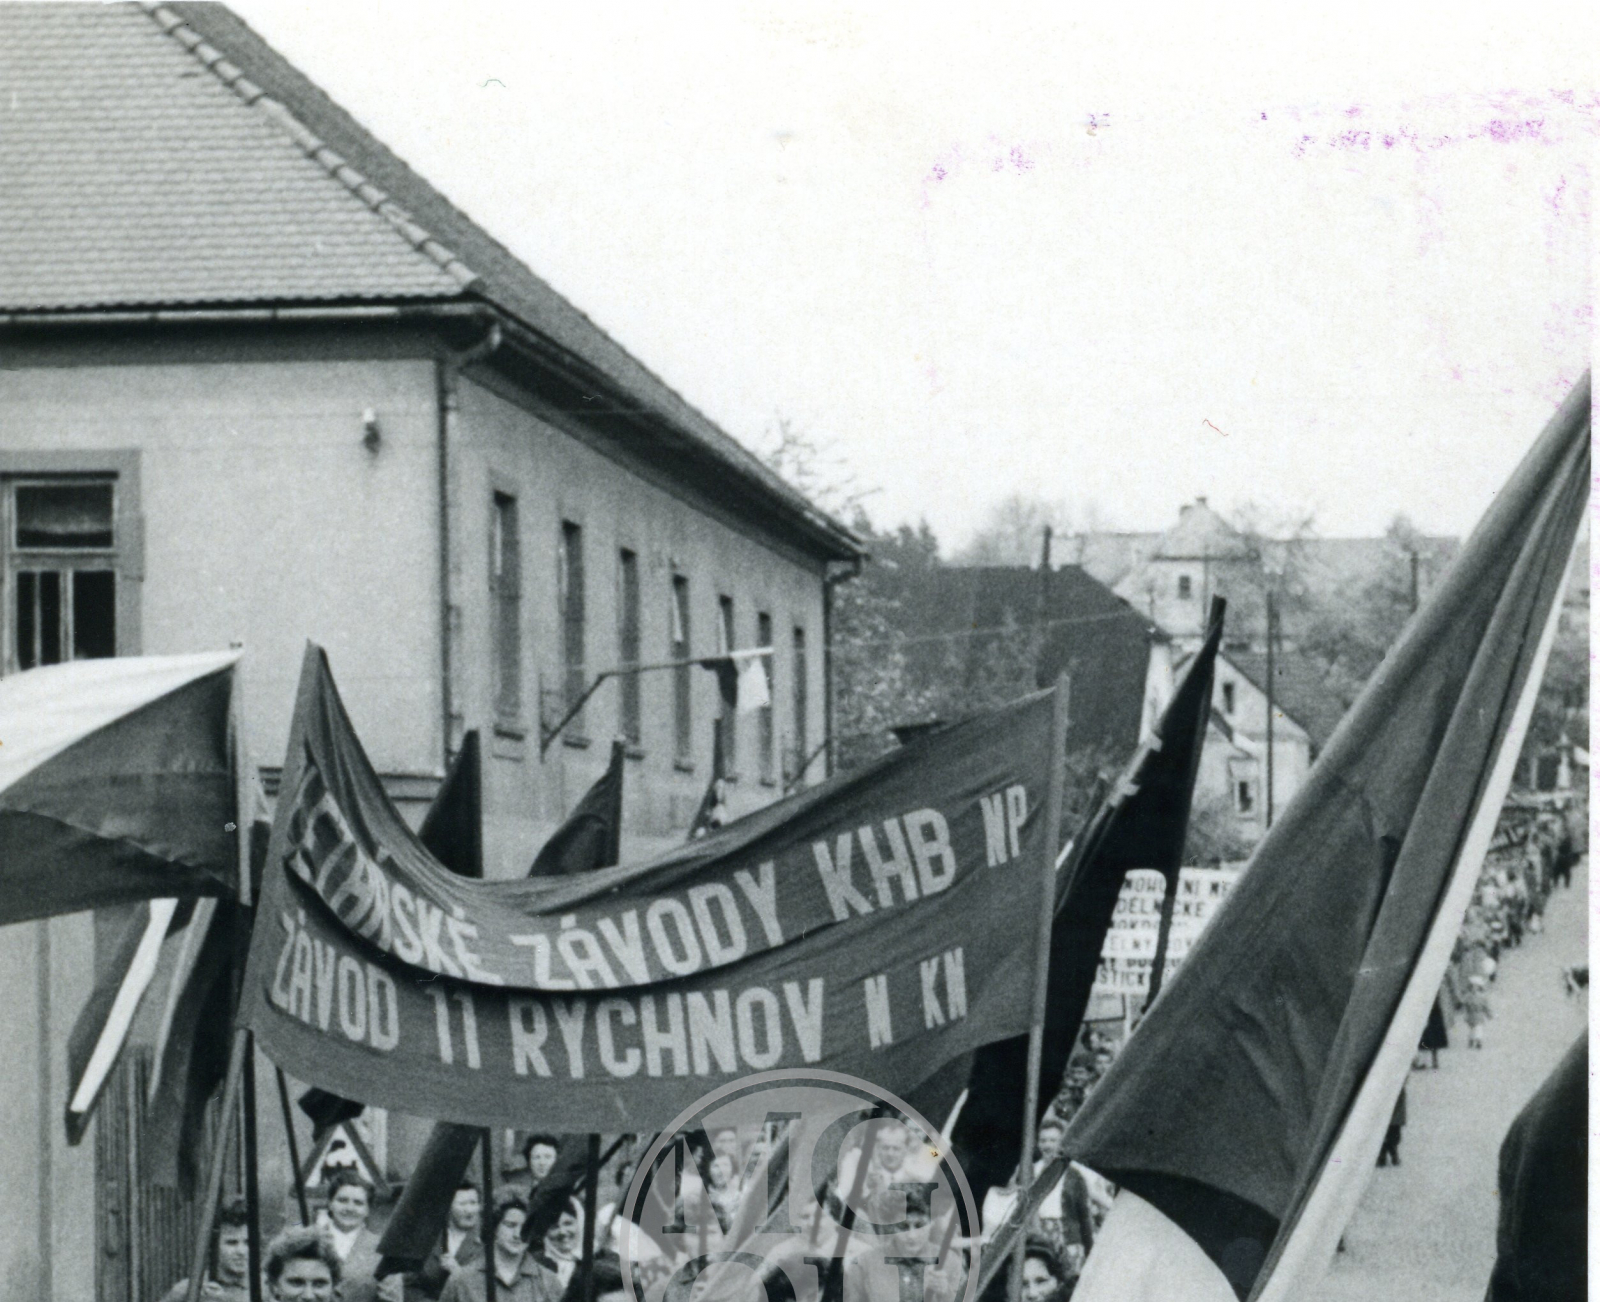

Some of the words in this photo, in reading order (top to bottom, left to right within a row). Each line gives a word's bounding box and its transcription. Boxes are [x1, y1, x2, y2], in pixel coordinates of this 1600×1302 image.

[509, 859, 784, 990] ZÁVODY
[812, 808, 957, 922] KHB
[979, 785, 1028, 868] NP
[271, 906, 400, 1051] ZÁVOD
[509, 977, 824, 1079] RYCHNOV
[864, 974, 893, 1050] N
[920, 946, 967, 1030] KN
